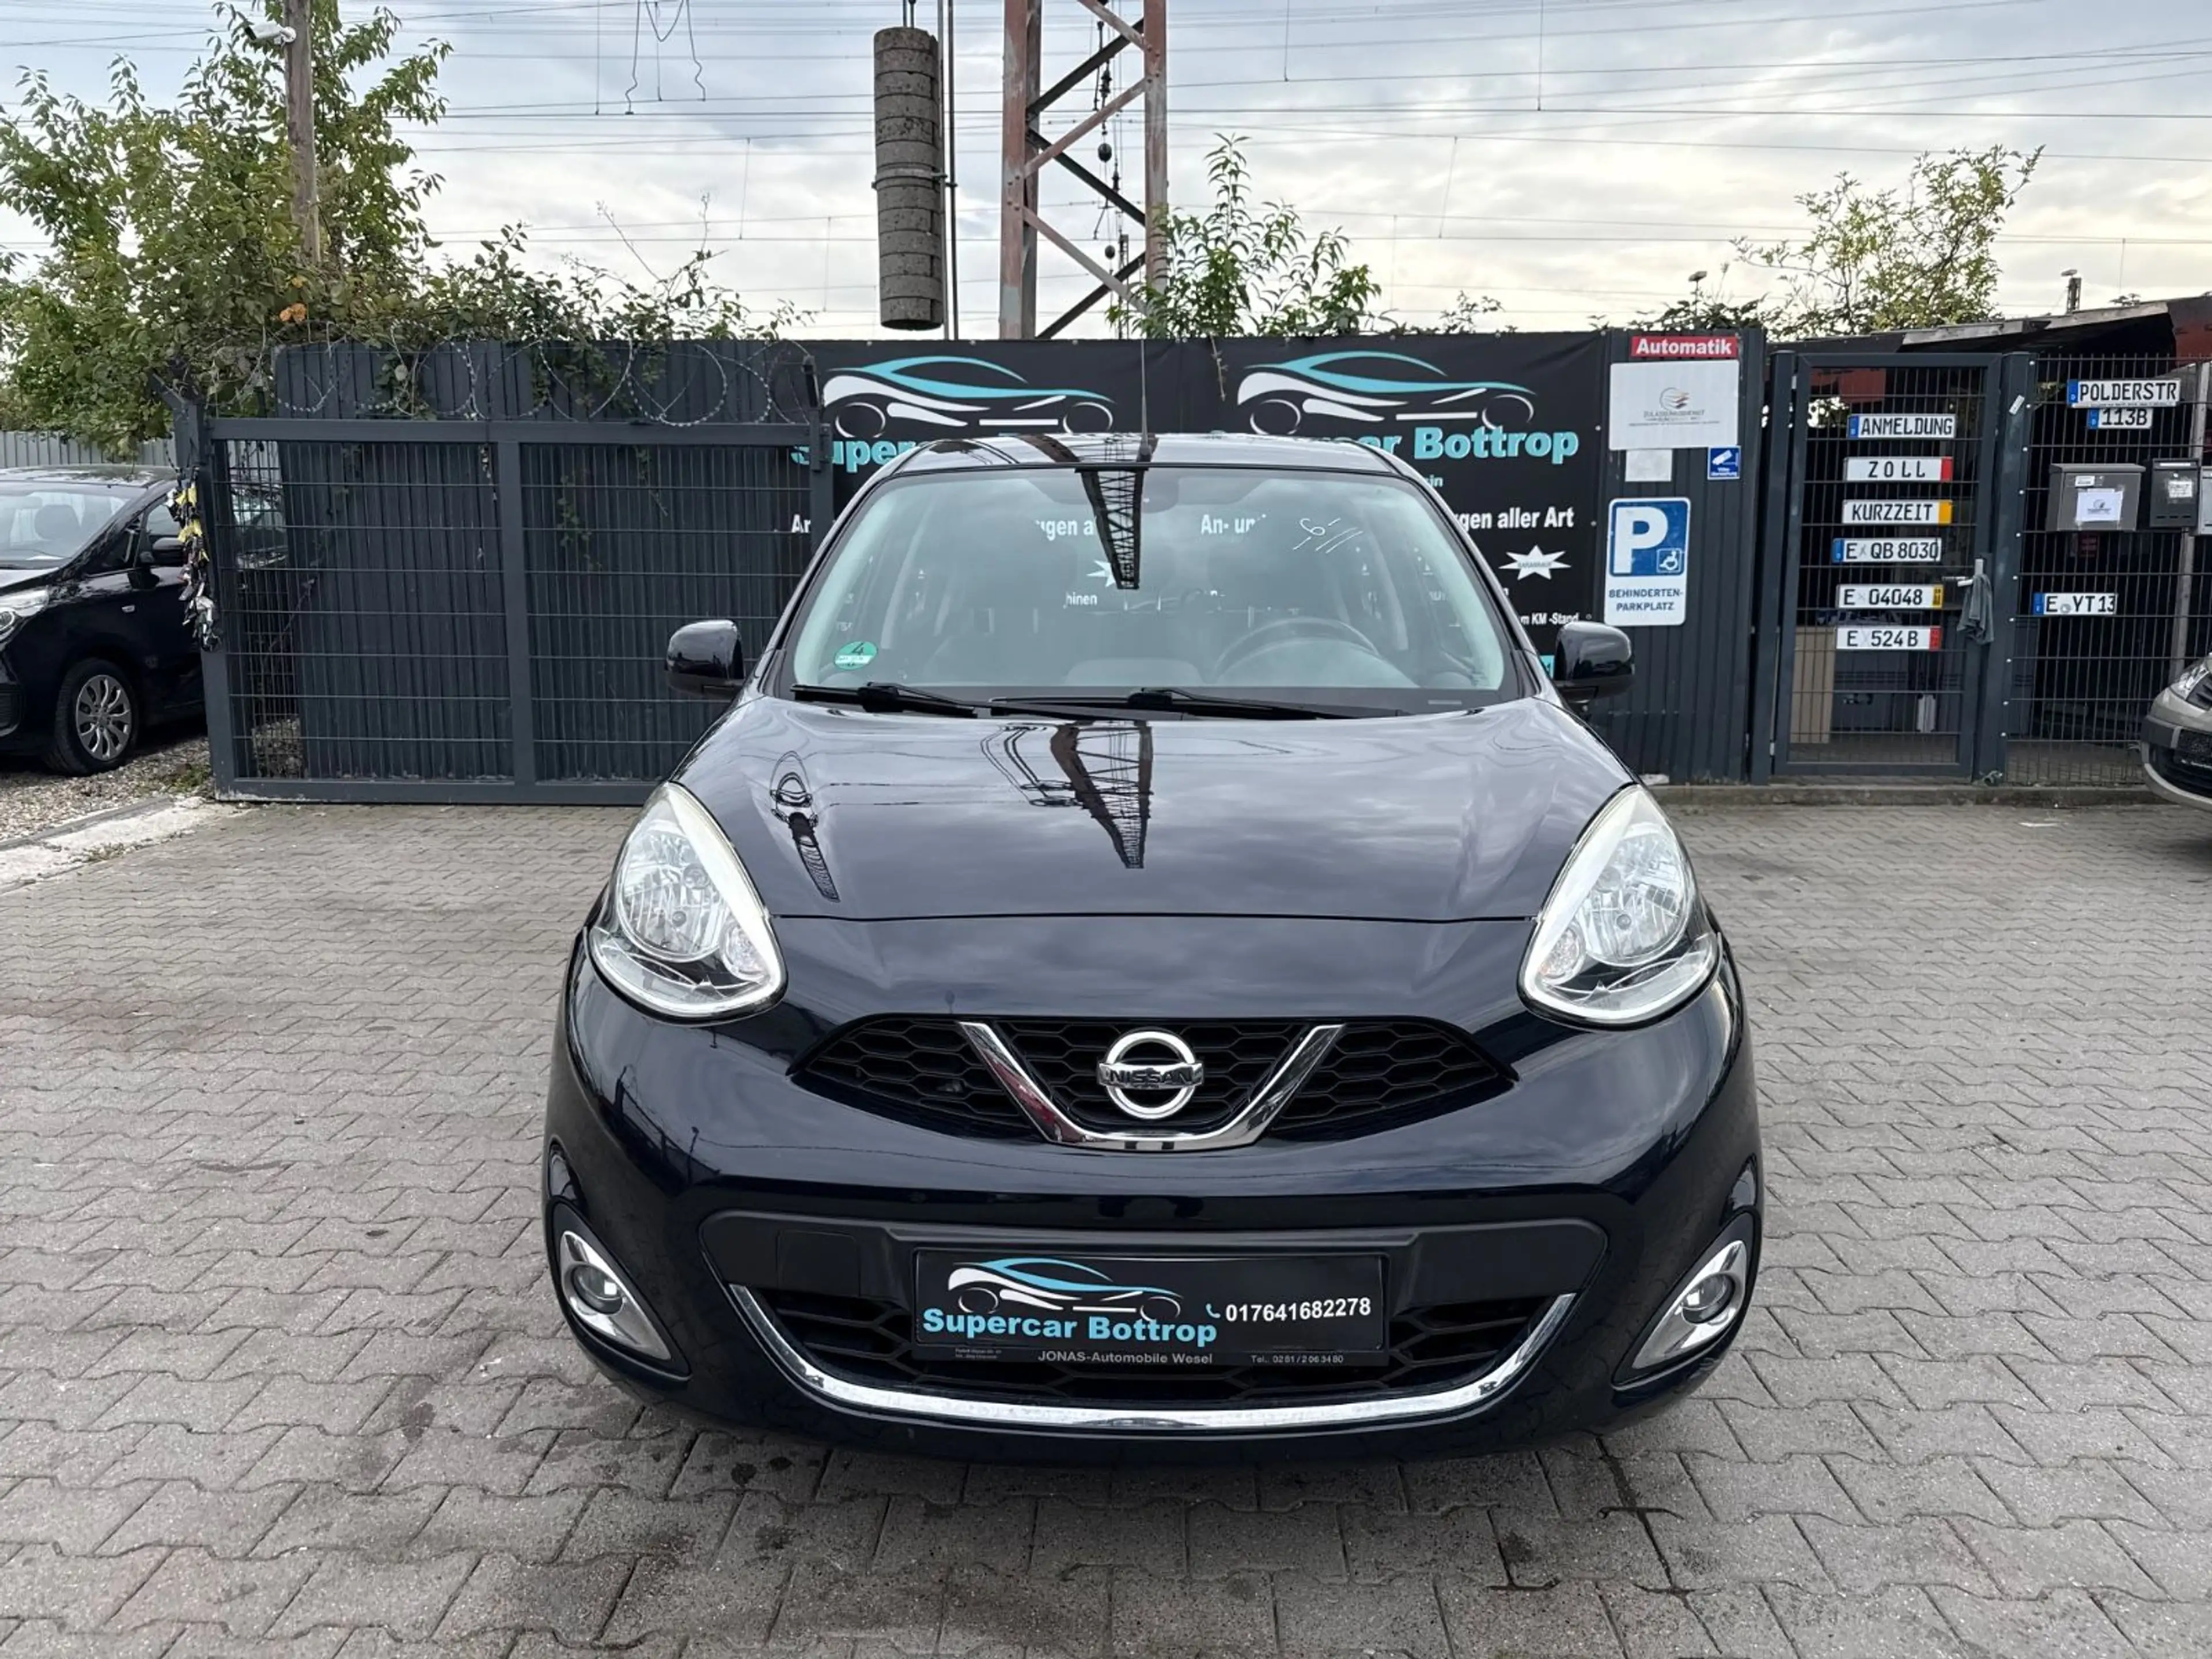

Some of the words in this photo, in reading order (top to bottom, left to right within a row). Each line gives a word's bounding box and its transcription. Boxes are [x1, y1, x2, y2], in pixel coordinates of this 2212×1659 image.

[1636, 338, 1732, 355] Automatik
[2080, 382, 2176, 401] POLDERSTR
[2101, 408, 2147, 426] 113B
[1861, 418, 1953, 435] ANMELDUNG
[1414, 426, 1579, 464] Bottrop
[1498, 507, 1540, 528] aller
[1544, 506, 1574, 528] Art
[1852, 503, 1933, 521] KURZZEIT
[1613, 506, 1668, 574] P
[1846, 543, 1858, 559] E
[1871, 542, 1893, 559] QB
[1897, 542, 1938, 559] 8030
[1609, 588, 1683, 598] BEHINDERTEN-
[1844, 589, 1855, 605] E
[1869, 589, 1923, 605] 04048
[1616, 602, 1675, 611] PARKPLATZ
[2046, 596, 2058, 612] E
[2072, 596, 2095, 612] YT
[1531, 612, 1548, 624] KM
[1847, 630, 1858, 646] E
[851, 642, 865, 655] 4
[1109, 1066, 1192, 1084] NISSAN
[1226, 1297, 1371, 1321] 017641682278
[923, 1308, 1078, 1338] Supercar
[1089, 1316, 1217, 1347] Bottrop
[1038, 1351, 1168, 1363] JONAS-Automobile
[1172, 1353, 1213, 1363] Wesel
